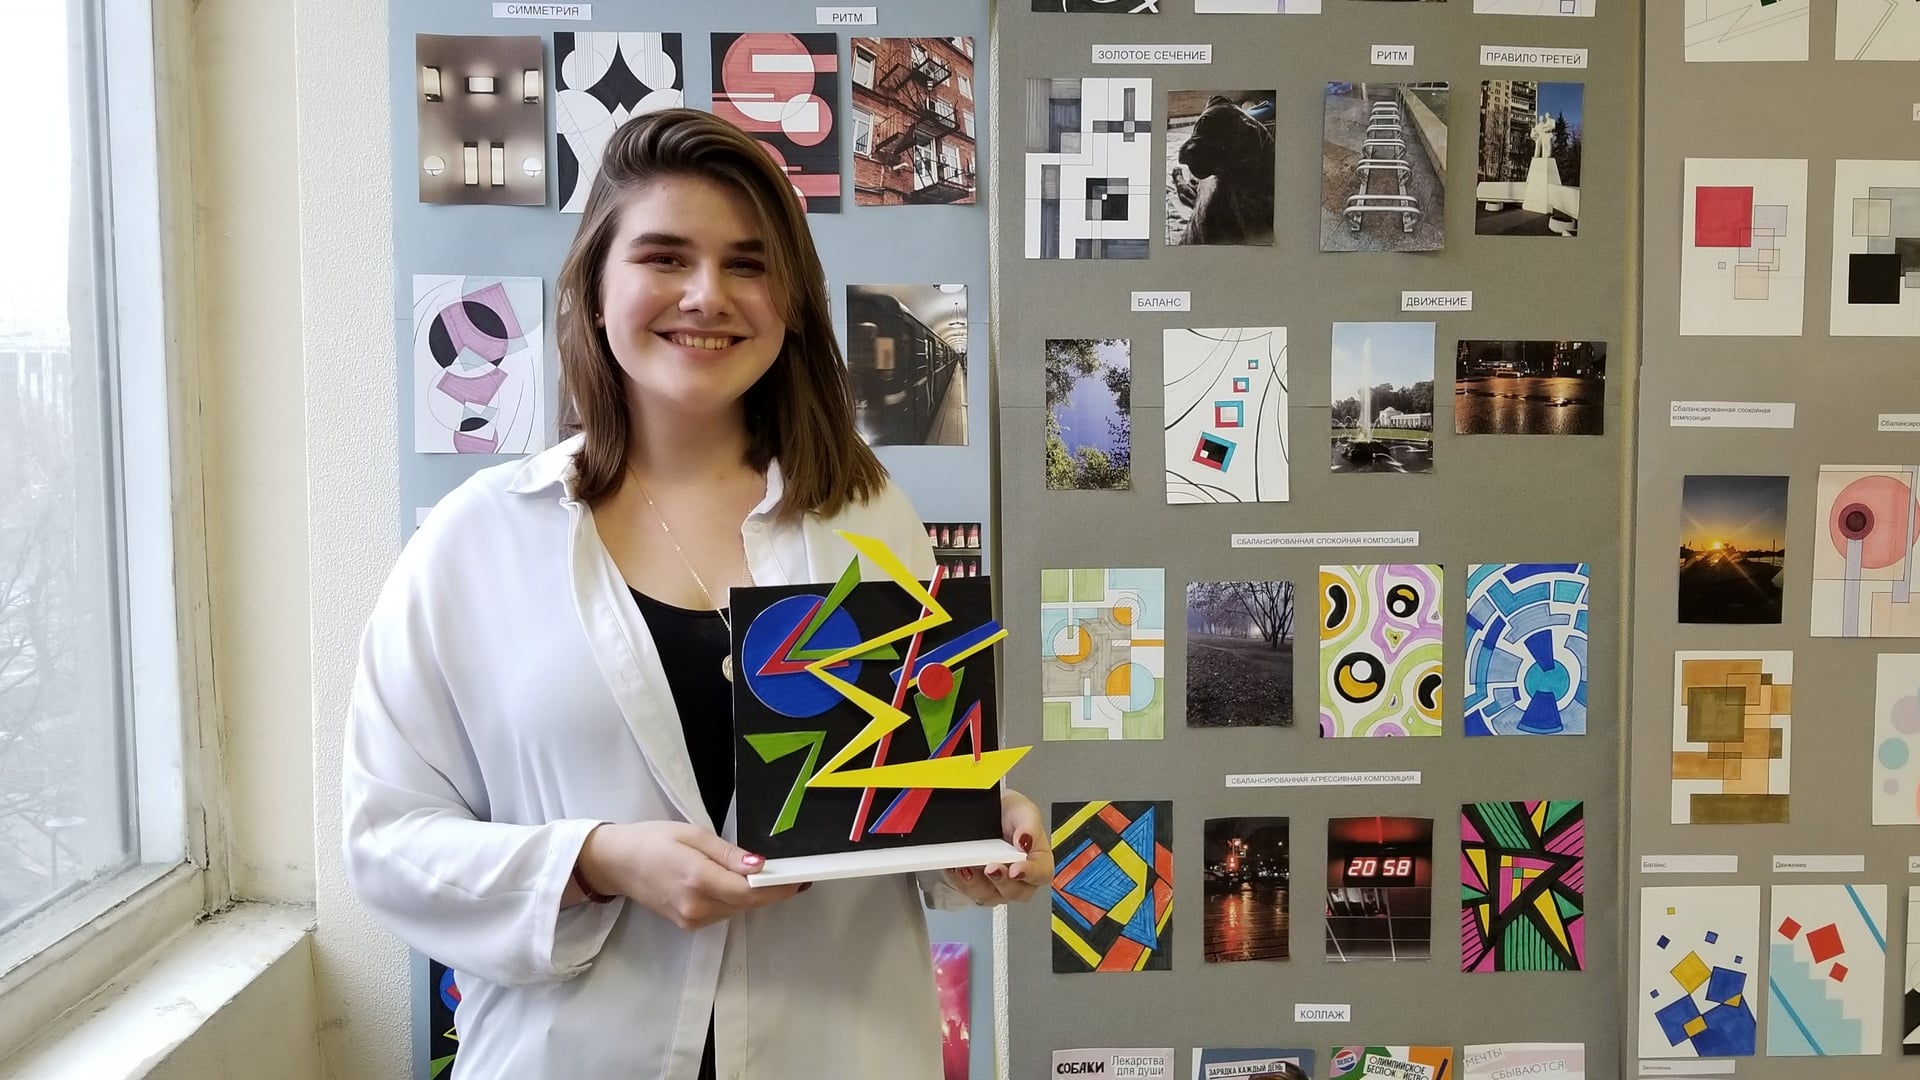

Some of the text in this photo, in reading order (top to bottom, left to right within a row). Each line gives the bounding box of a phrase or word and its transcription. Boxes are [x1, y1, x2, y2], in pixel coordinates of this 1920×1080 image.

[507, 5, 579, 16] СИММЕТРИЯ
[832, 13, 863, 22] РИТМ
[1098, 50, 1206, 60] ЗОЛОТОЕ СЕЧЕНИЕ
[1377, 51, 1408, 60] РИТМ
[1486, 52, 1581, 64] ПРАВИЛО ТРЕТЕЙ
[1137, 298, 1181, 307] БАЛАНС
[1406, 297, 1467, 307] ДВИЖЕНИЕ
[1672, 405, 1736, 414] Сбалансированная
[1672, 414, 1711, 422] композиция
[1316, 536, 1361, 545] СПОКОЙНАЯ
[1362, 537, 1414, 545] КОМПОЗИЦИЯ
[1231, 775, 1415, 785] СБАЛАНСИРОВАННАЯ АГРЕССИВНАЯ КОМПОЗИЦИЯ
[1347, 859, 1412, 876] 20 58
[1300, 1010, 1345, 1019] КОЛЛАЖ
[1111, 1055, 1164, 1068] Лекарства
[1465, 1048, 1503, 1068] МЕЧТЫ
[1057, 1062, 1104, 1075] СОБАКИ
[1208, 1063, 1283, 1076] ЗАРЯДКА КАЖДЫЙ ДЕНЬ
[1369, 1055, 1426, 1074] ОЛИМПИЙСКОЕ
[1116, 1068, 1164, 1078] для души
[1491, 1060, 1568, 1080] СБЫВАЮТСЯ!
